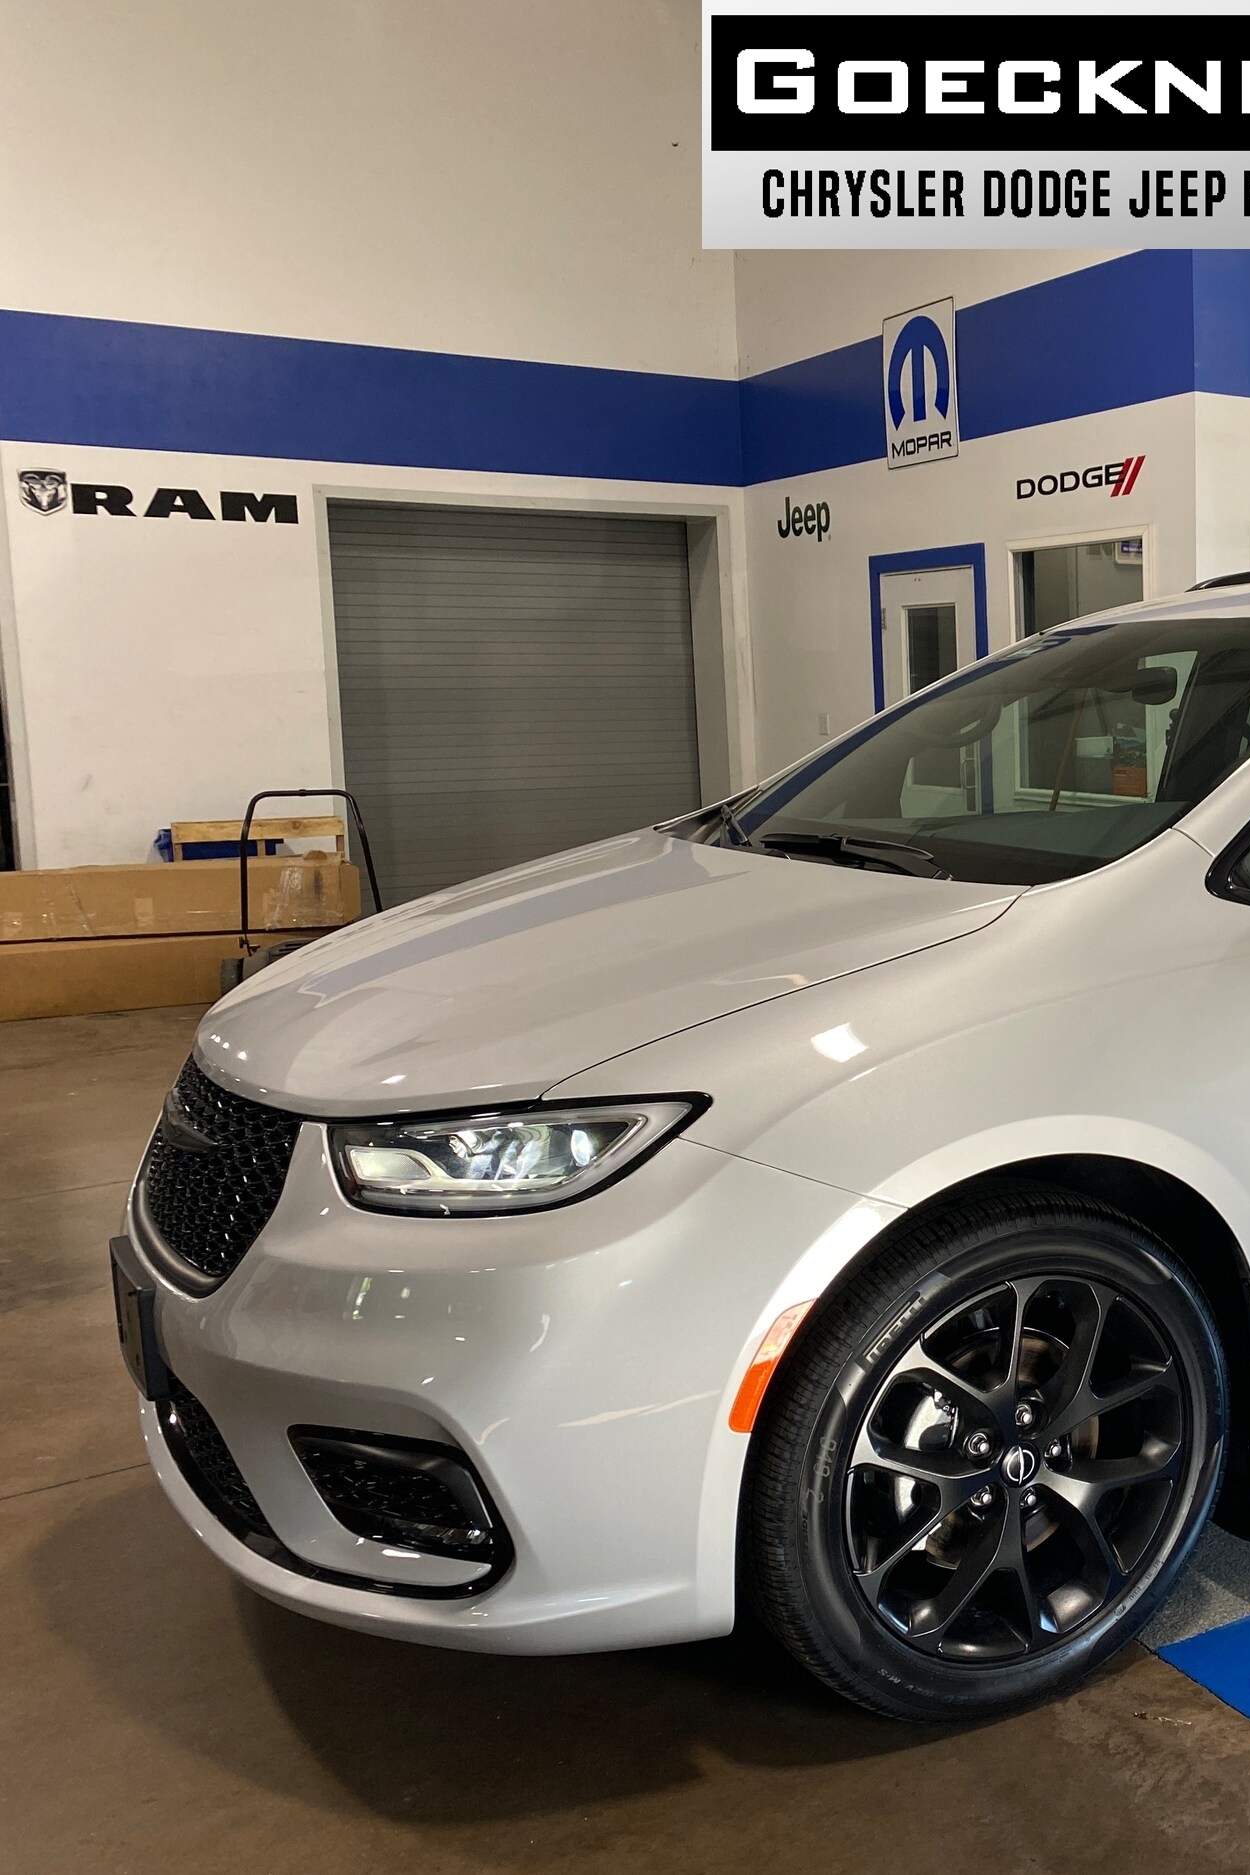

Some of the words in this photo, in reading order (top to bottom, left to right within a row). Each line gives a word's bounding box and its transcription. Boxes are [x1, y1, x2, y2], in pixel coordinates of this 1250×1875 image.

[891, 430, 952, 460] MOPAR
[1016, 461, 1126, 500] DODGE
[70, 482, 299, 525] RAM
[777, 495, 831, 543] Jeep
[854, 1290, 927, 1373] PIRELLI
